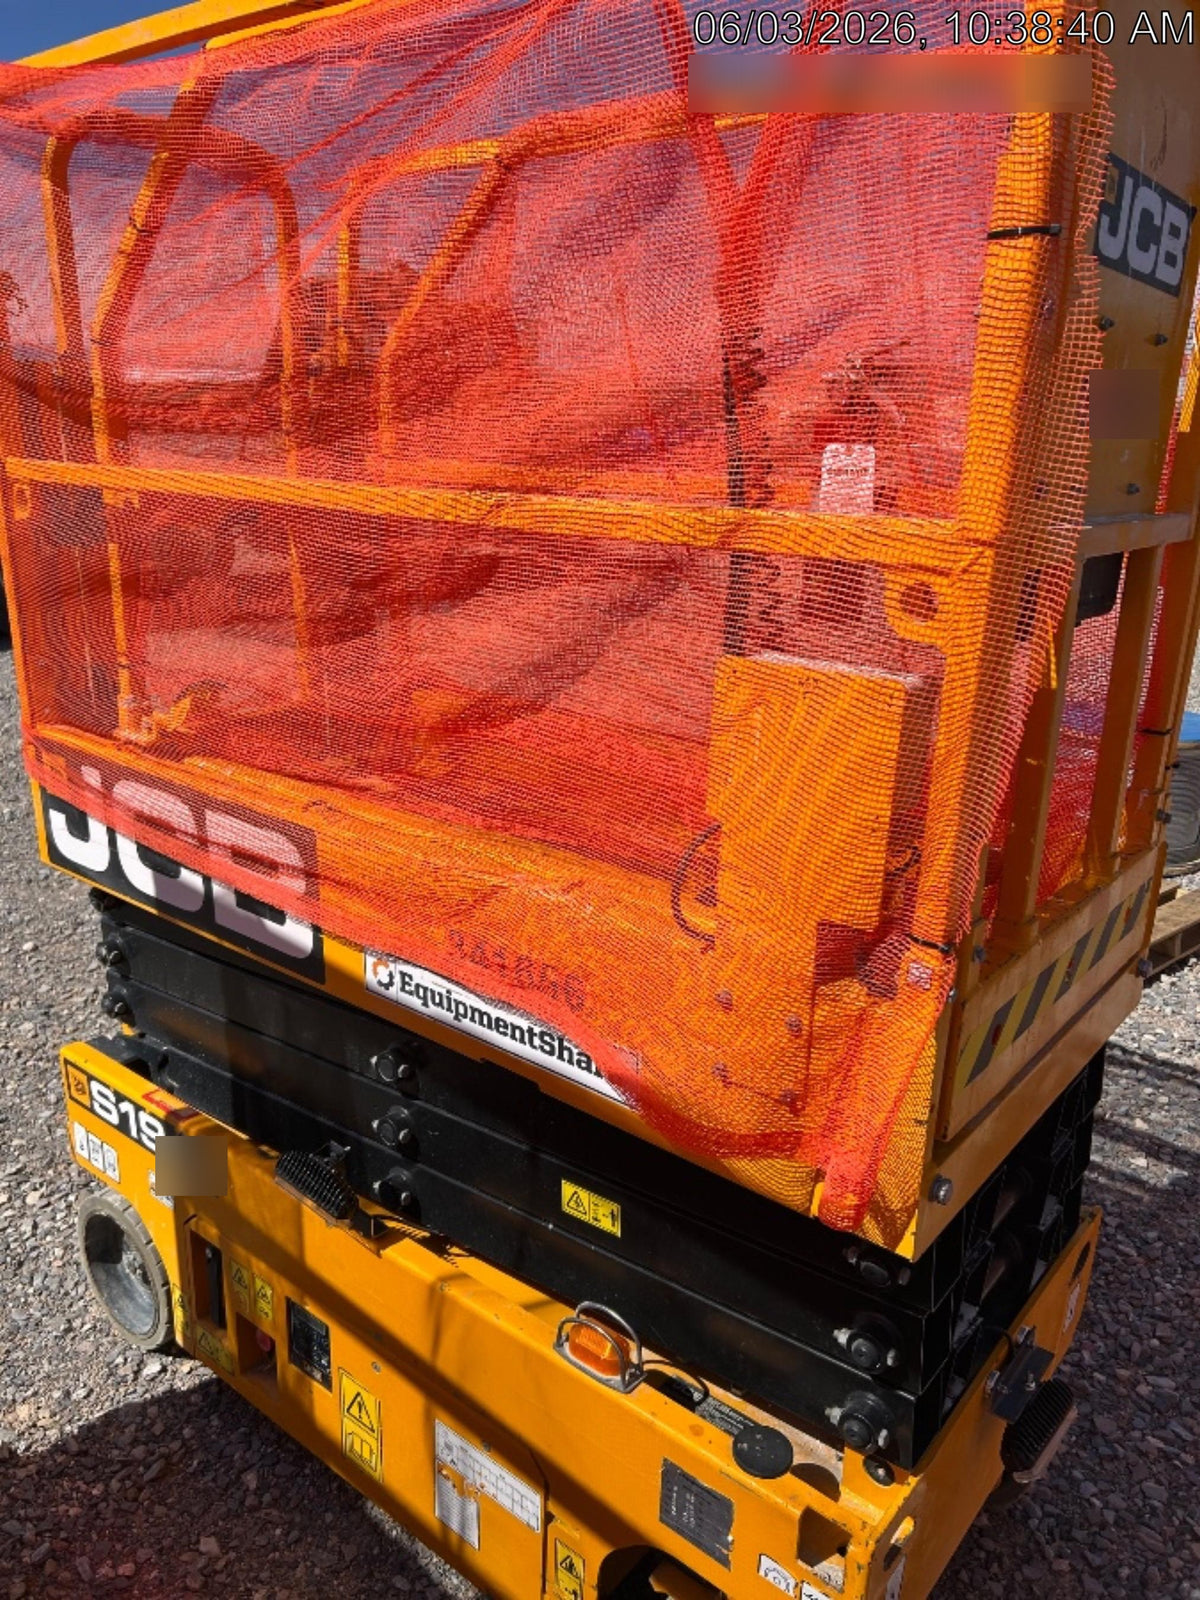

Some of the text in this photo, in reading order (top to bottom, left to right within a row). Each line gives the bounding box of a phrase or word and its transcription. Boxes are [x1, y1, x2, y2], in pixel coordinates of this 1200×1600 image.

[1100, 173, 1190, 287] JCB
[49, 764, 314, 959] JCB
[399, 969, 605, 1080] EquipmentSha
